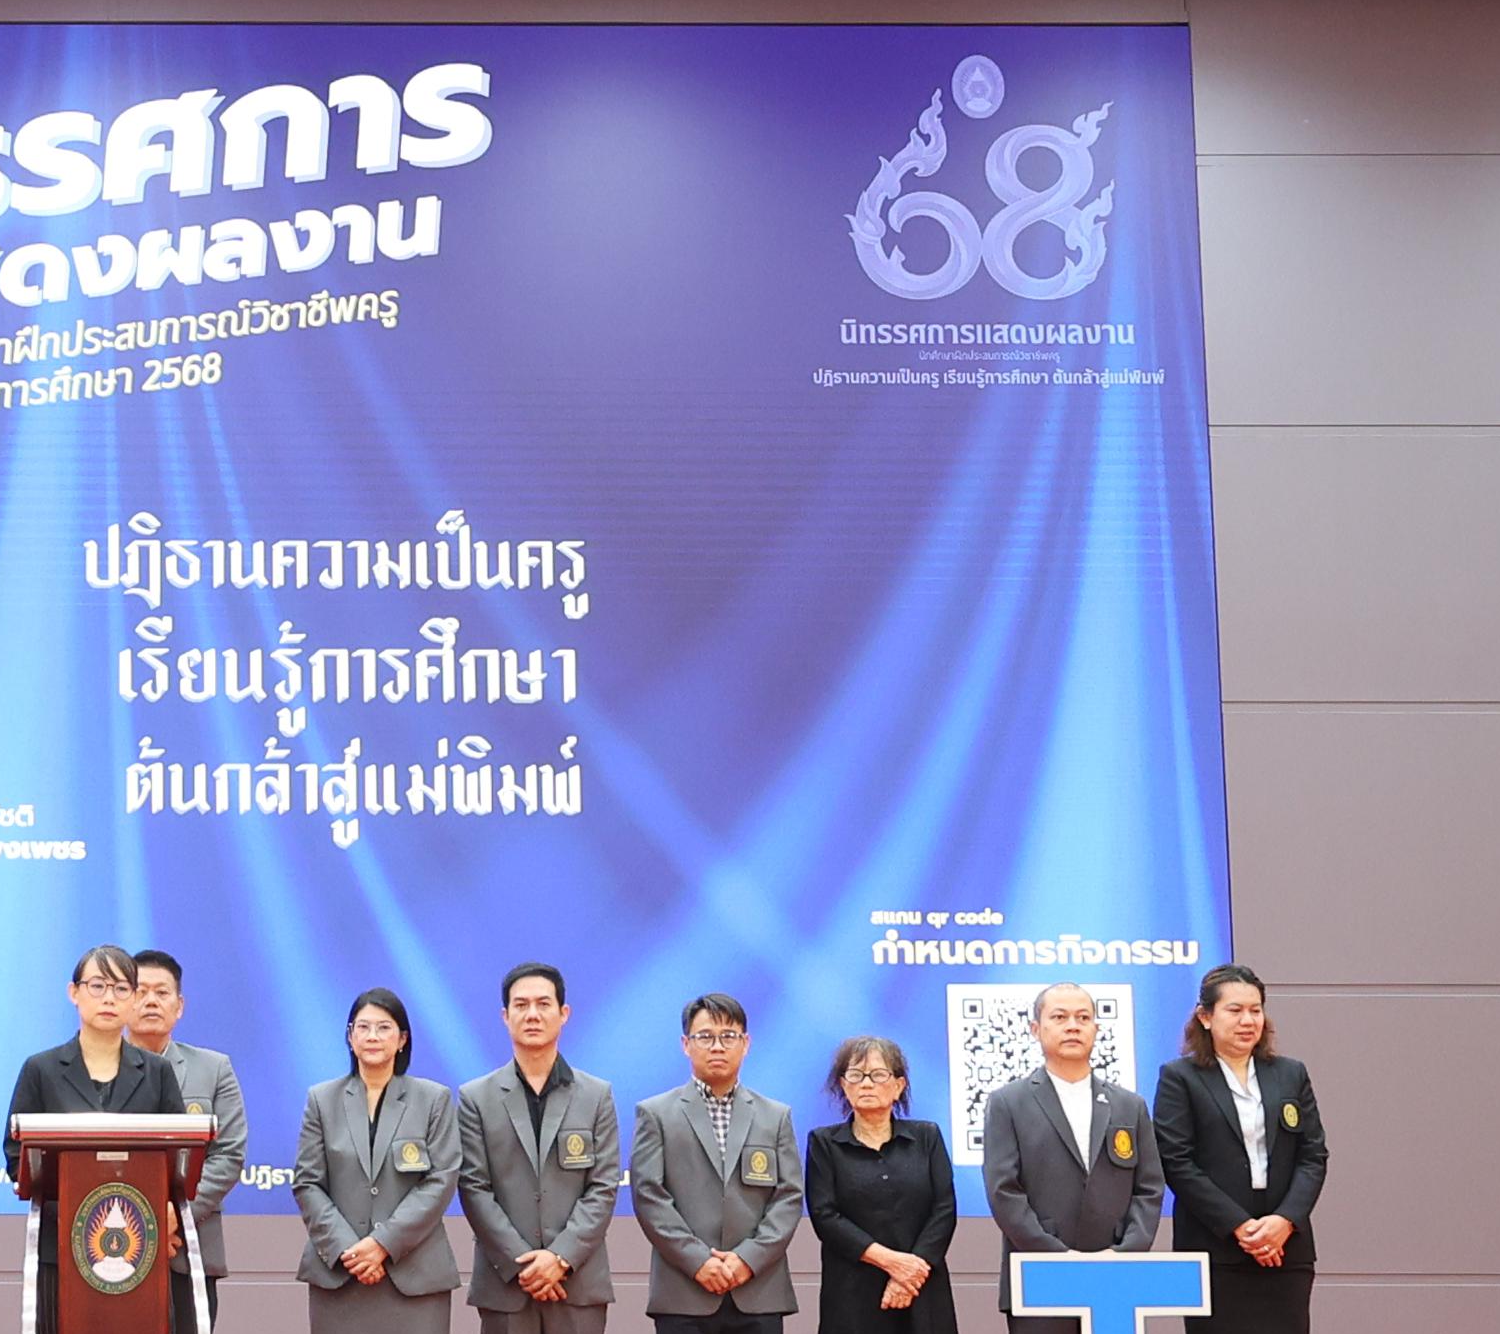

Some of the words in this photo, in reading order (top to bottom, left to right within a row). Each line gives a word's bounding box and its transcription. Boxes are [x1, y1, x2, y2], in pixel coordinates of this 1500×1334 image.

[840, 318, 1136, 346] นิทรรศการแสดงผลงาน
[142, 351, 223, 392] 2568
[943, 368, 1049, 389] เรียนรู้การศึกษา
[118, 616, 577, 737] เรียนรู้การศึกษา
[125, 735, 582, 849] ต้นกล้าสู่แม่พิมพ์
[927, 911, 950, 929] qr
[954, 908, 1004, 926] code
[872, 929, 1200, 965] กำหนดการกิจกรรม
